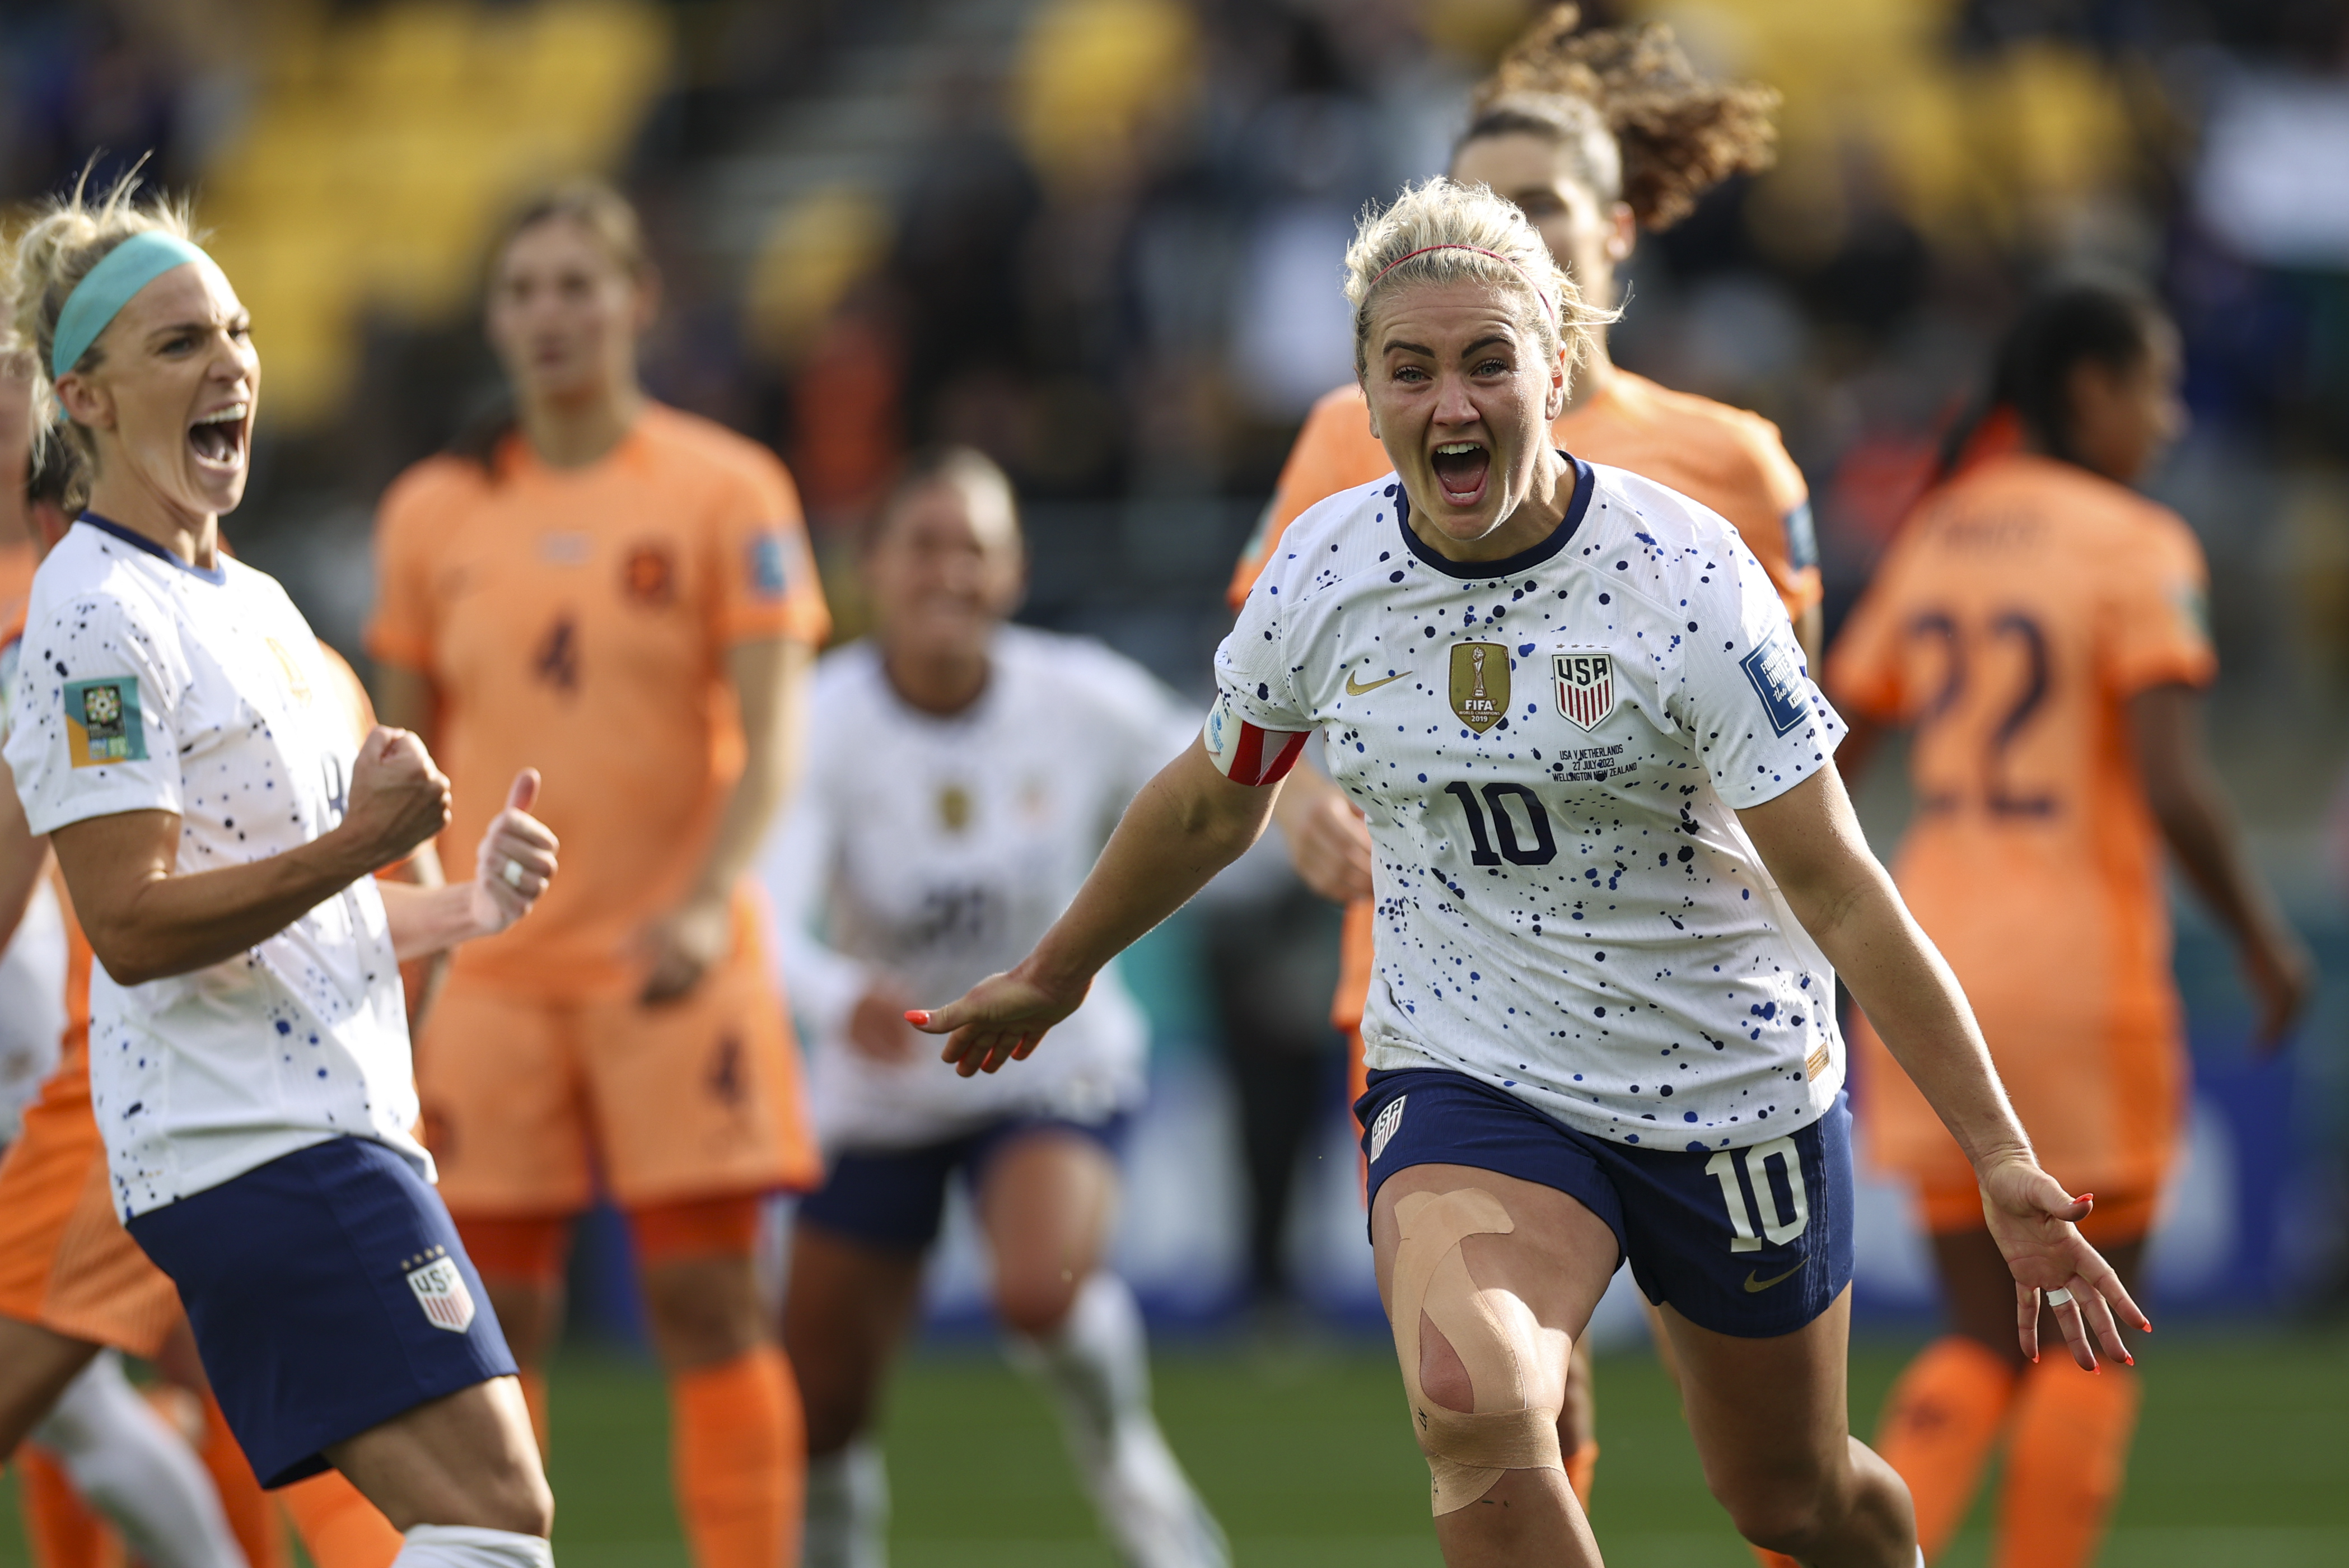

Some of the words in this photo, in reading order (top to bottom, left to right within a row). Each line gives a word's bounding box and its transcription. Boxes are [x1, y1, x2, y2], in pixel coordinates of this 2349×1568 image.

[534, 612, 581, 700] 4
[1760, 645, 1785, 674] FOOTBAL
[1557, 658, 1608, 686] USA
[1766, 656, 1792, 688] UNITE
[1465, 700, 1493, 711] FIFA
[1773, 687, 1787, 702] the
[1791, 690, 1802, 704] FIFA
[1907, 609, 2056, 820] 22
[1559, 750, 1572, 760] USA
[1573, 750, 1578, 760] V
[1579, 744, 1624, 759] NETHERLANDS
[1572, 762, 1580, 771] 27
[1582, 760, 1596, 771] JULY
[1598, 757, 1615, 768] 2023
[1552, 772, 1594, 782] WELLINGTON
[1610, 762, 1637, 777] ZEALAND
[1444, 781, 1557, 866] 10
[1374, 1099, 1403, 1138] USA
[1705, 1135, 1809, 1253] 10
